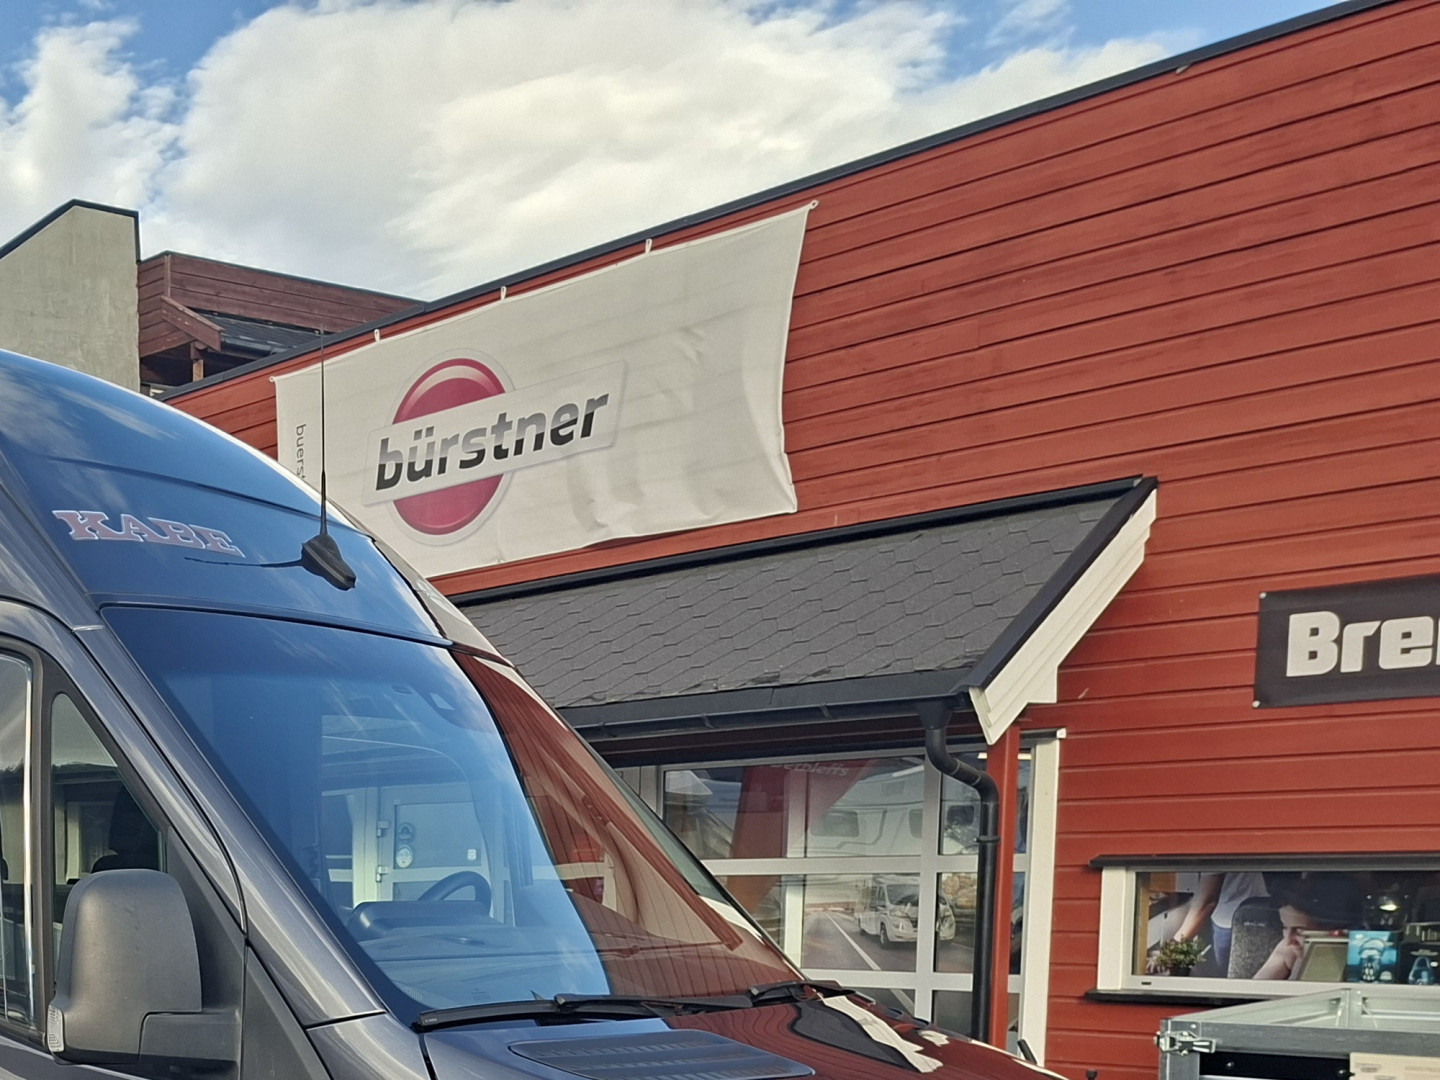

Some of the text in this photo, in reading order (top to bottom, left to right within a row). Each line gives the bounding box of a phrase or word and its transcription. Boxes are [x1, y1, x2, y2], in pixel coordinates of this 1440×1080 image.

[295, 423, 307, 480] buers
[375, 392, 610, 491] bürstner
[51, 509, 246, 558] KABE
[1285, 611, 1440, 677] Bre
